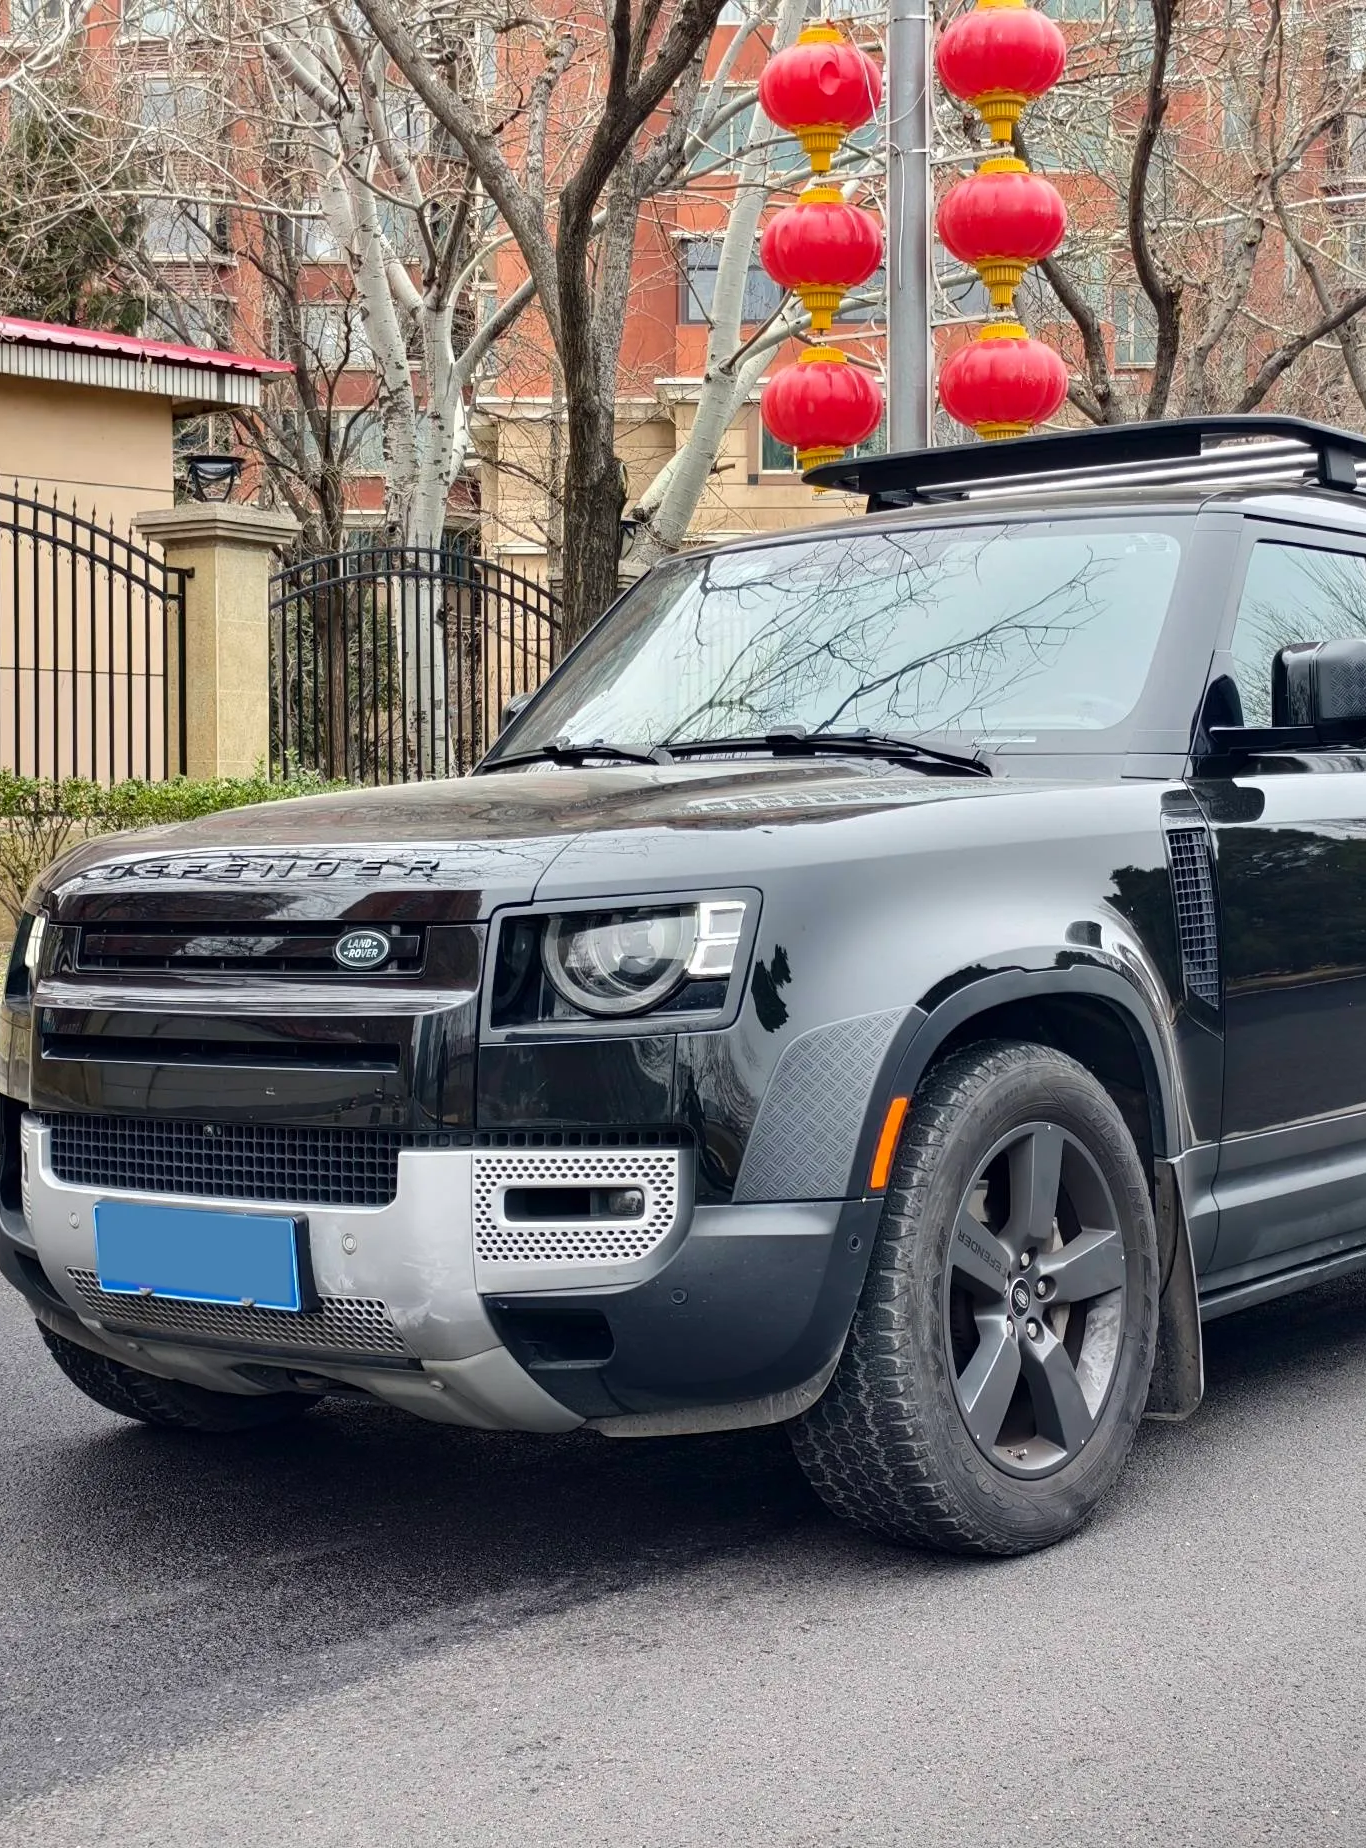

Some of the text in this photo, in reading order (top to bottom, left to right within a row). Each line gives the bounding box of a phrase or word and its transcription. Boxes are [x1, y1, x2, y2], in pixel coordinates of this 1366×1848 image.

[103, 858, 439, 880] DEFENDER
[347, 939, 372, 948] LAND
[348, 948, 378, 957] ROVER
